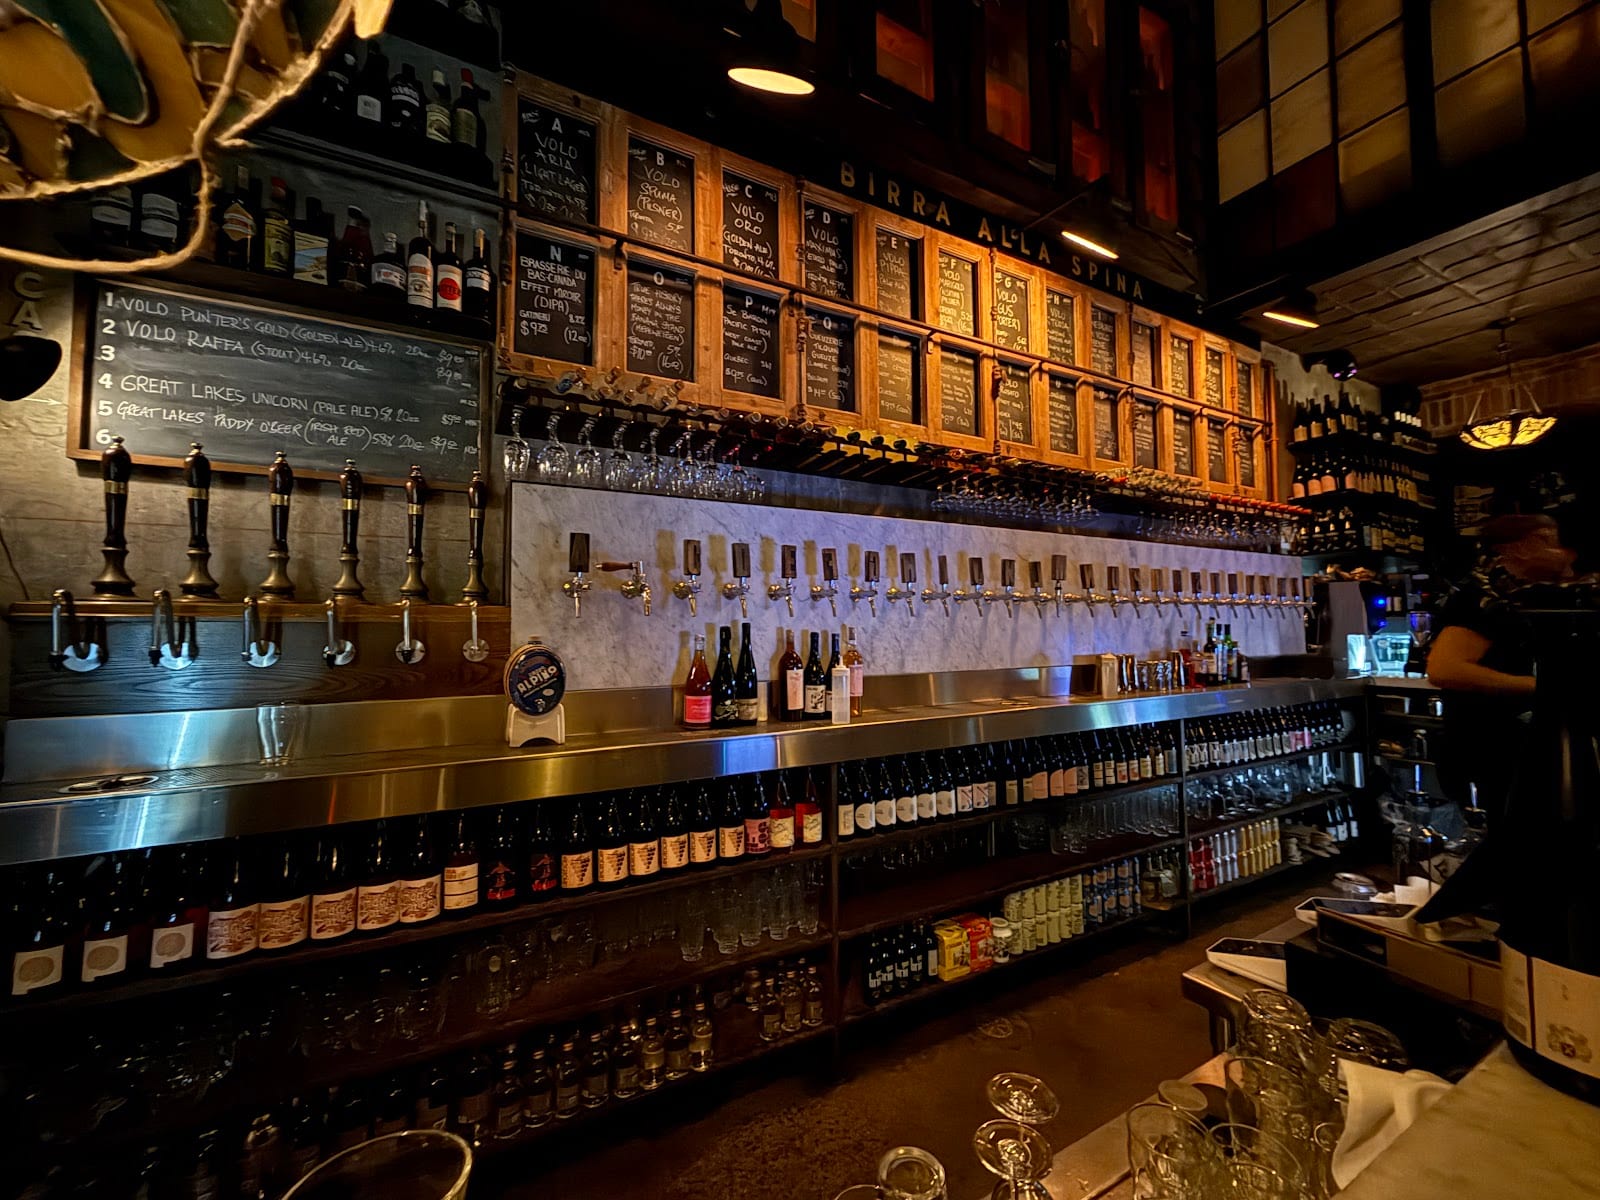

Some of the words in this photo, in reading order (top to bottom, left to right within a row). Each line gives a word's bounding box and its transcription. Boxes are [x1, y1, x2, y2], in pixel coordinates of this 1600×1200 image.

[552, 118, 563, 134] A
[534, 131, 578, 160] VOLO
[656, 152, 665, 166] B
[644, 165, 680, 188] VOLO
[745, 185, 752, 198] C
[731, 202, 764, 222] VOLO
[823, 212, 831, 224] D
[734, 218, 762, 235] ORO
[841, 161, 951, 226] BIRRA
[977, 217, 1051, 264] ALLA
[1071, 255, 1143, 301] SPINA
[811, 225, 839, 245] VOLO
[891, 237, 897, 249] E
[550, 245, 562, 262] N
[883, 252, 905, 267] VOLO
[520, 255, 571, 276] BRASSERIE
[574, 269, 586, 281] DU
[951, 259, 956, 269] F
[943, 269, 960, 281] VOLO
[1005, 277, 1011, 288] G
[521, 280, 551, 294] EFFET
[745, 296, 753, 308] P
[997, 288, 1017, 303] VOLO
[1054, 295, 1059, 305] H
[534, 294, 569, 316] (DIPA)
[105, 292, 114, 307] 1
[121, 297, 168, 316] VOLO
[180, 306, 250, 331] PUNTER'S
[255, 321, 289, 338] GOLD
[823, 316, 832, 330] Q
[102, 319, 116, 334] 2
[126, 320, 176, 341] VOLO
[187, 330, 244, 354] RAFFA
[251, 340, 301, 363] (STOUT)
[100, 345, 115, 361] 3
[98, 373, 113, 389] 4
[120, 375, 184, 395] GREAT
[192, 383, 246, 403] LAKES
[252, 392, 308, 411] UNICORN
[313, 401, 347, 415] (PALE
[351, 404, 378, 419] ALE)
[98, 400, 113, 416] 5
[117, 401, 161, 420] GREAT
[162, 409, 205, 424] LAKES
[214, 413, 254, 431] PADDY
[96, 429, 112, 445] 6
